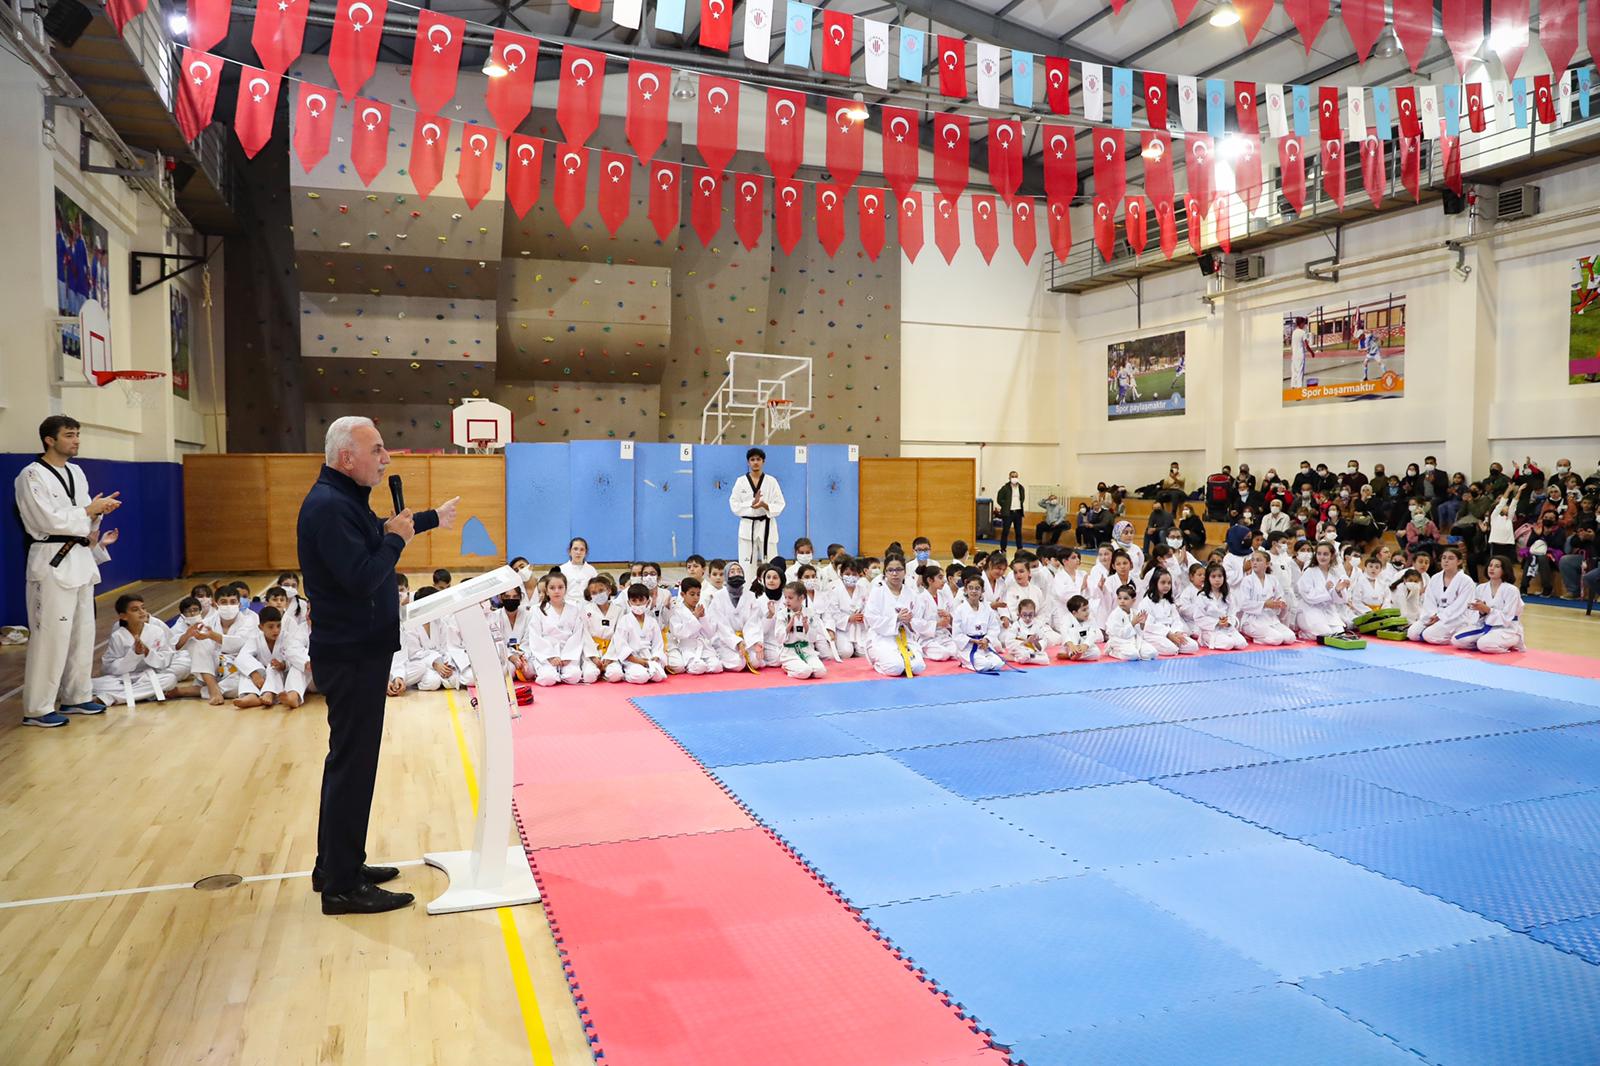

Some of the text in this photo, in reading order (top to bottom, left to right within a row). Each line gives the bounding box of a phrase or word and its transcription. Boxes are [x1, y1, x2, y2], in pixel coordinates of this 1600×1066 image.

[1302, 383, 1375, 398] Spor başarmaktır
[1115, 405, 1129, 413] Spor
[683, 448, 689, 456] 6
